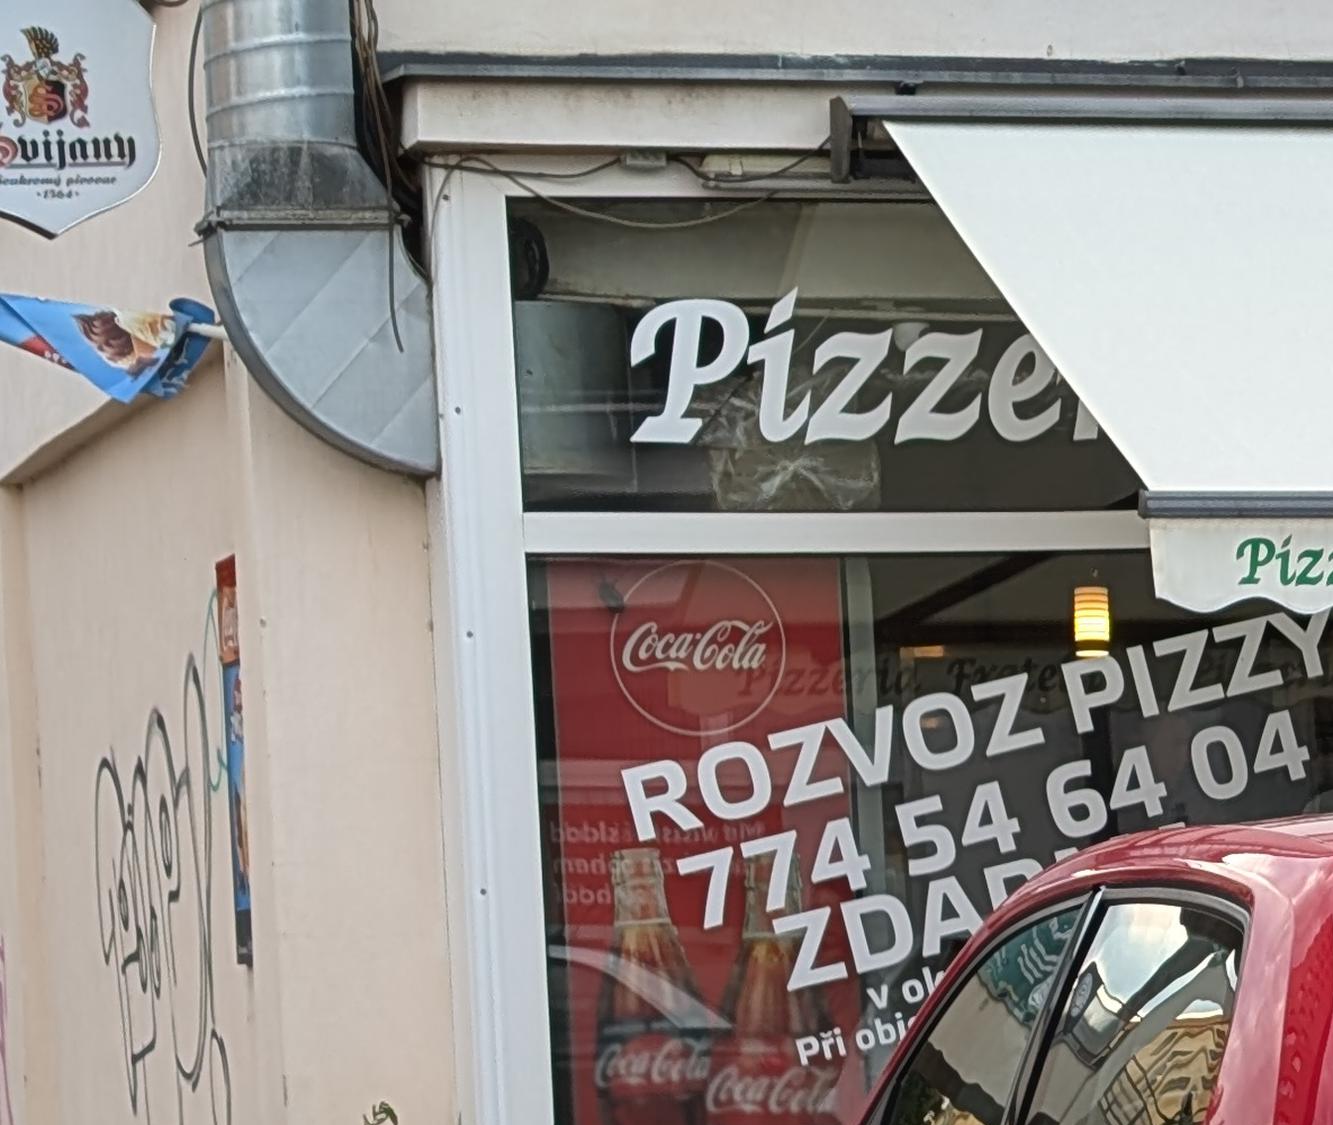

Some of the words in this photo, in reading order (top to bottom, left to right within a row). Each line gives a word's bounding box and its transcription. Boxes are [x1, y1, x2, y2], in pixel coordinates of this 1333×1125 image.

[622, 620, 774, 673] Coca-Cola
[621, 676, 1046, 842] ROZVOZ
[1061, 608, 1330, 736] PIZZY
[676, 819, 872, 930] 774
[895, 783, 1022, 878] 54
[1045, 745, 1168, 841] 64
[1190, 711, 1313, 801] 04
[796, 1027, 847, 1067] Při
